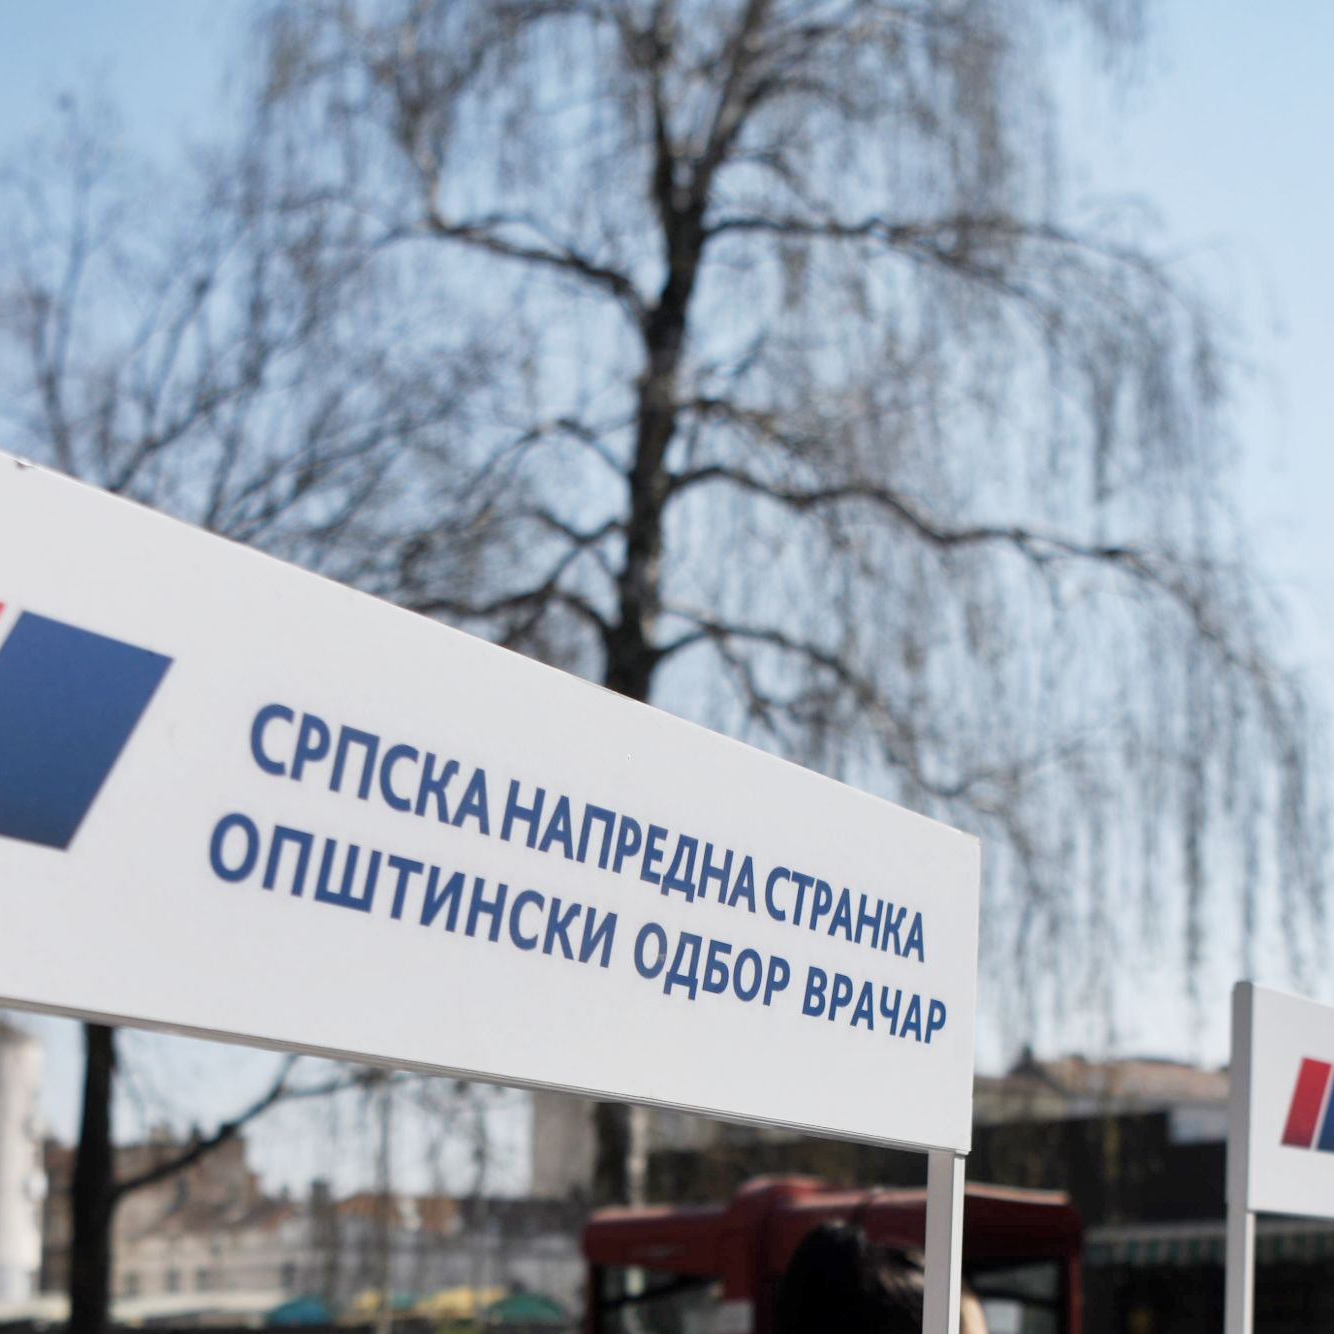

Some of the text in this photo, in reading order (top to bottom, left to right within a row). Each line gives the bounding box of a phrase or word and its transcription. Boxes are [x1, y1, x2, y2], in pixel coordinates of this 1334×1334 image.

[209, 811, 948, 1045] ОПШТИНСКИ ОДБОР ВРАЧАР
[250, 703, 925, 964] СРПСКА НАПРЕДНА СТРАНКА
